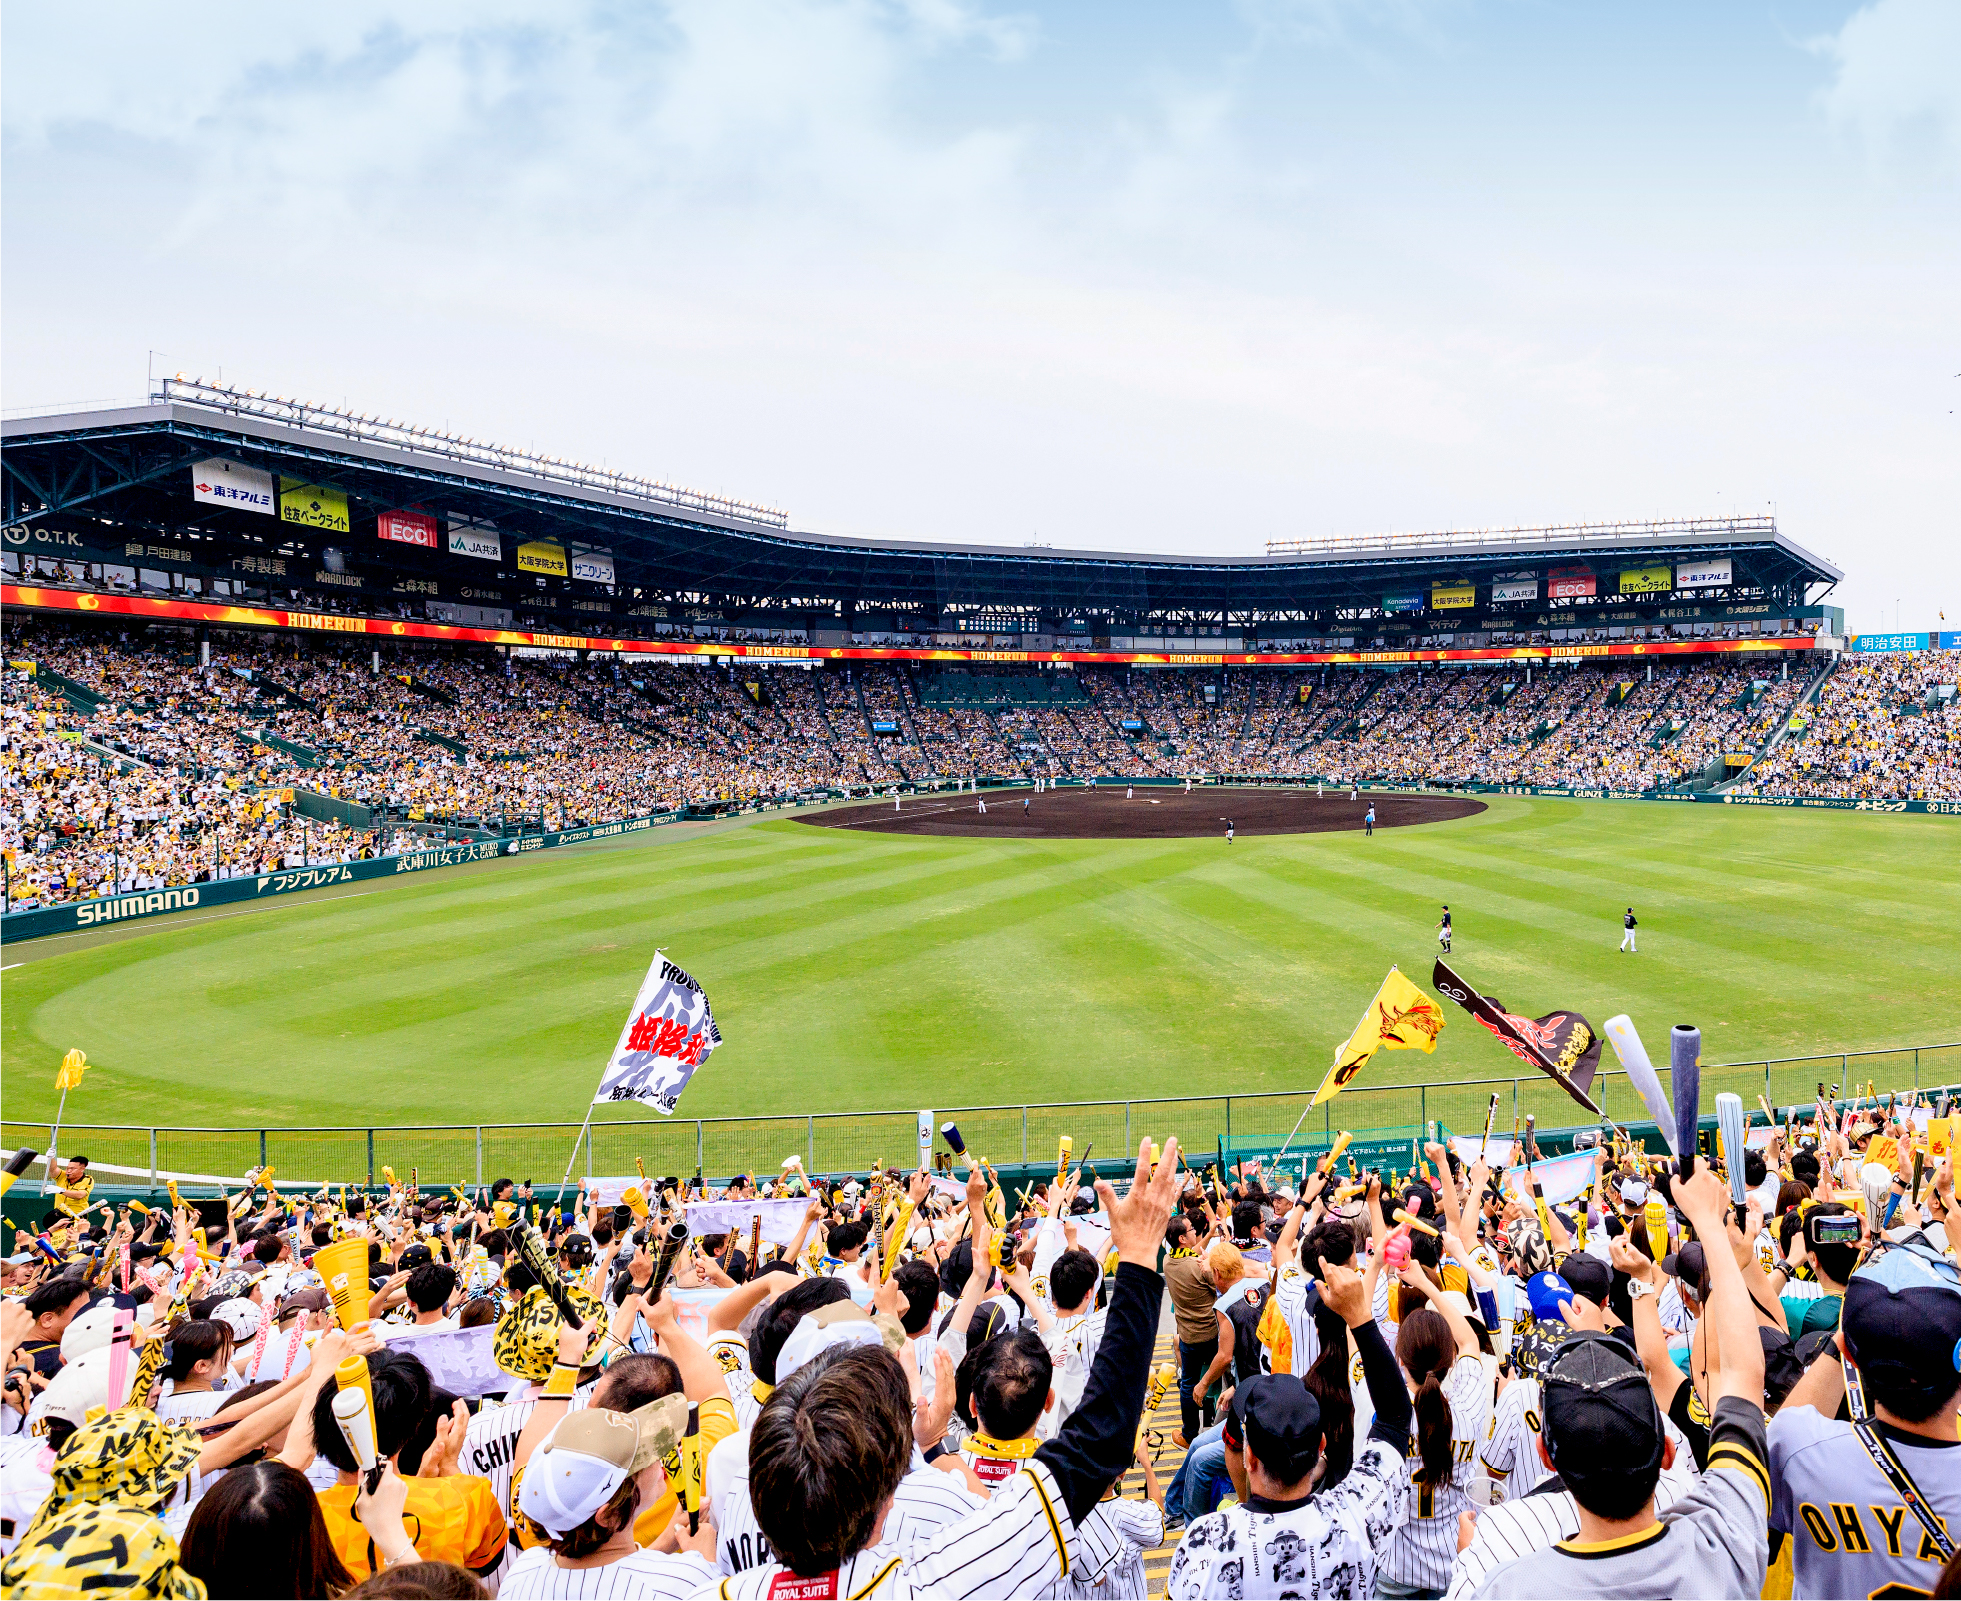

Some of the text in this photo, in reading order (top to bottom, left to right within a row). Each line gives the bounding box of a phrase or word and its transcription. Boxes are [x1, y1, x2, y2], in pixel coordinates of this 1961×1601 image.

[213, 485, 270, 505] 東洋アルミ
[284, 505, 347, 530] 住友ベークライト
[35, 528, 84, 547] O.T.K.
[391, 523, 427, 543] ECC
[147, 545, 191, 562] 戸田建設
[469, 542, 499, 556] JA共済
[519, 554, 565, 571] 大阪学院大学
[575, 563, 613, 581] サニクリーン
[1690, 573, 1729, 582] 東洋アルミ
[405, 579, 438, 595] 森本組
[1556, 584, 1586, 596] ECC
[1621, 581, 1671, 592] 住友ベークライト
[1508, 589, 1536, 599] JA共済
[1387, 597, 1419, 605] Kanadevia
[1433, 596, 1473, 606] 大阪学院大学
[287, 611, 367, 633] HOMERUN
[1550, 612, 1576, 622] 森本組
[1427, 619, 1462, 630] マイティア
[533, 633, 587, 649] HOMERUN
[1861, 635, 1917, 650] 明治安田
[745, 645, 810, 658] HOMERUN
[970, 651, 1028, 661] HOMERUN
[1360, 651, 1411, 661] HOMERUN
[1551, 645, 1609, 657] HOMERUN
[1169, 654, 1223, 664] HOMERUN
[1726, 755, 1752, 766] TMG
[1500, 786, 1531, 796] 大和証券
[1573, 789, 1603, 799] GUNZE
[1735, 796, 1795, 805] レンタルのニッケン
[1855, 799, 1907, 812] オービック
[564, 831, 591, 842] レイズネクスト
[479, 842, 499, 852] MUKO
[396, 845, 479, 872] 武庫川女子大
[479, 850, 499, 860] GAWA
[274, 866, 353, 892] フジプレアム
[76, 887, 200, 926] SHIMANO
[44, 1403, 67, 1412] Tigers
[1869, 1443, 1894, 1475] Tigers
[994, 1468, 1012, 1476] SUITE
[1252, 1541, 1261, 1577] HANSHIN
[773, 1583, 830, 1601] ROYAL SUITE
